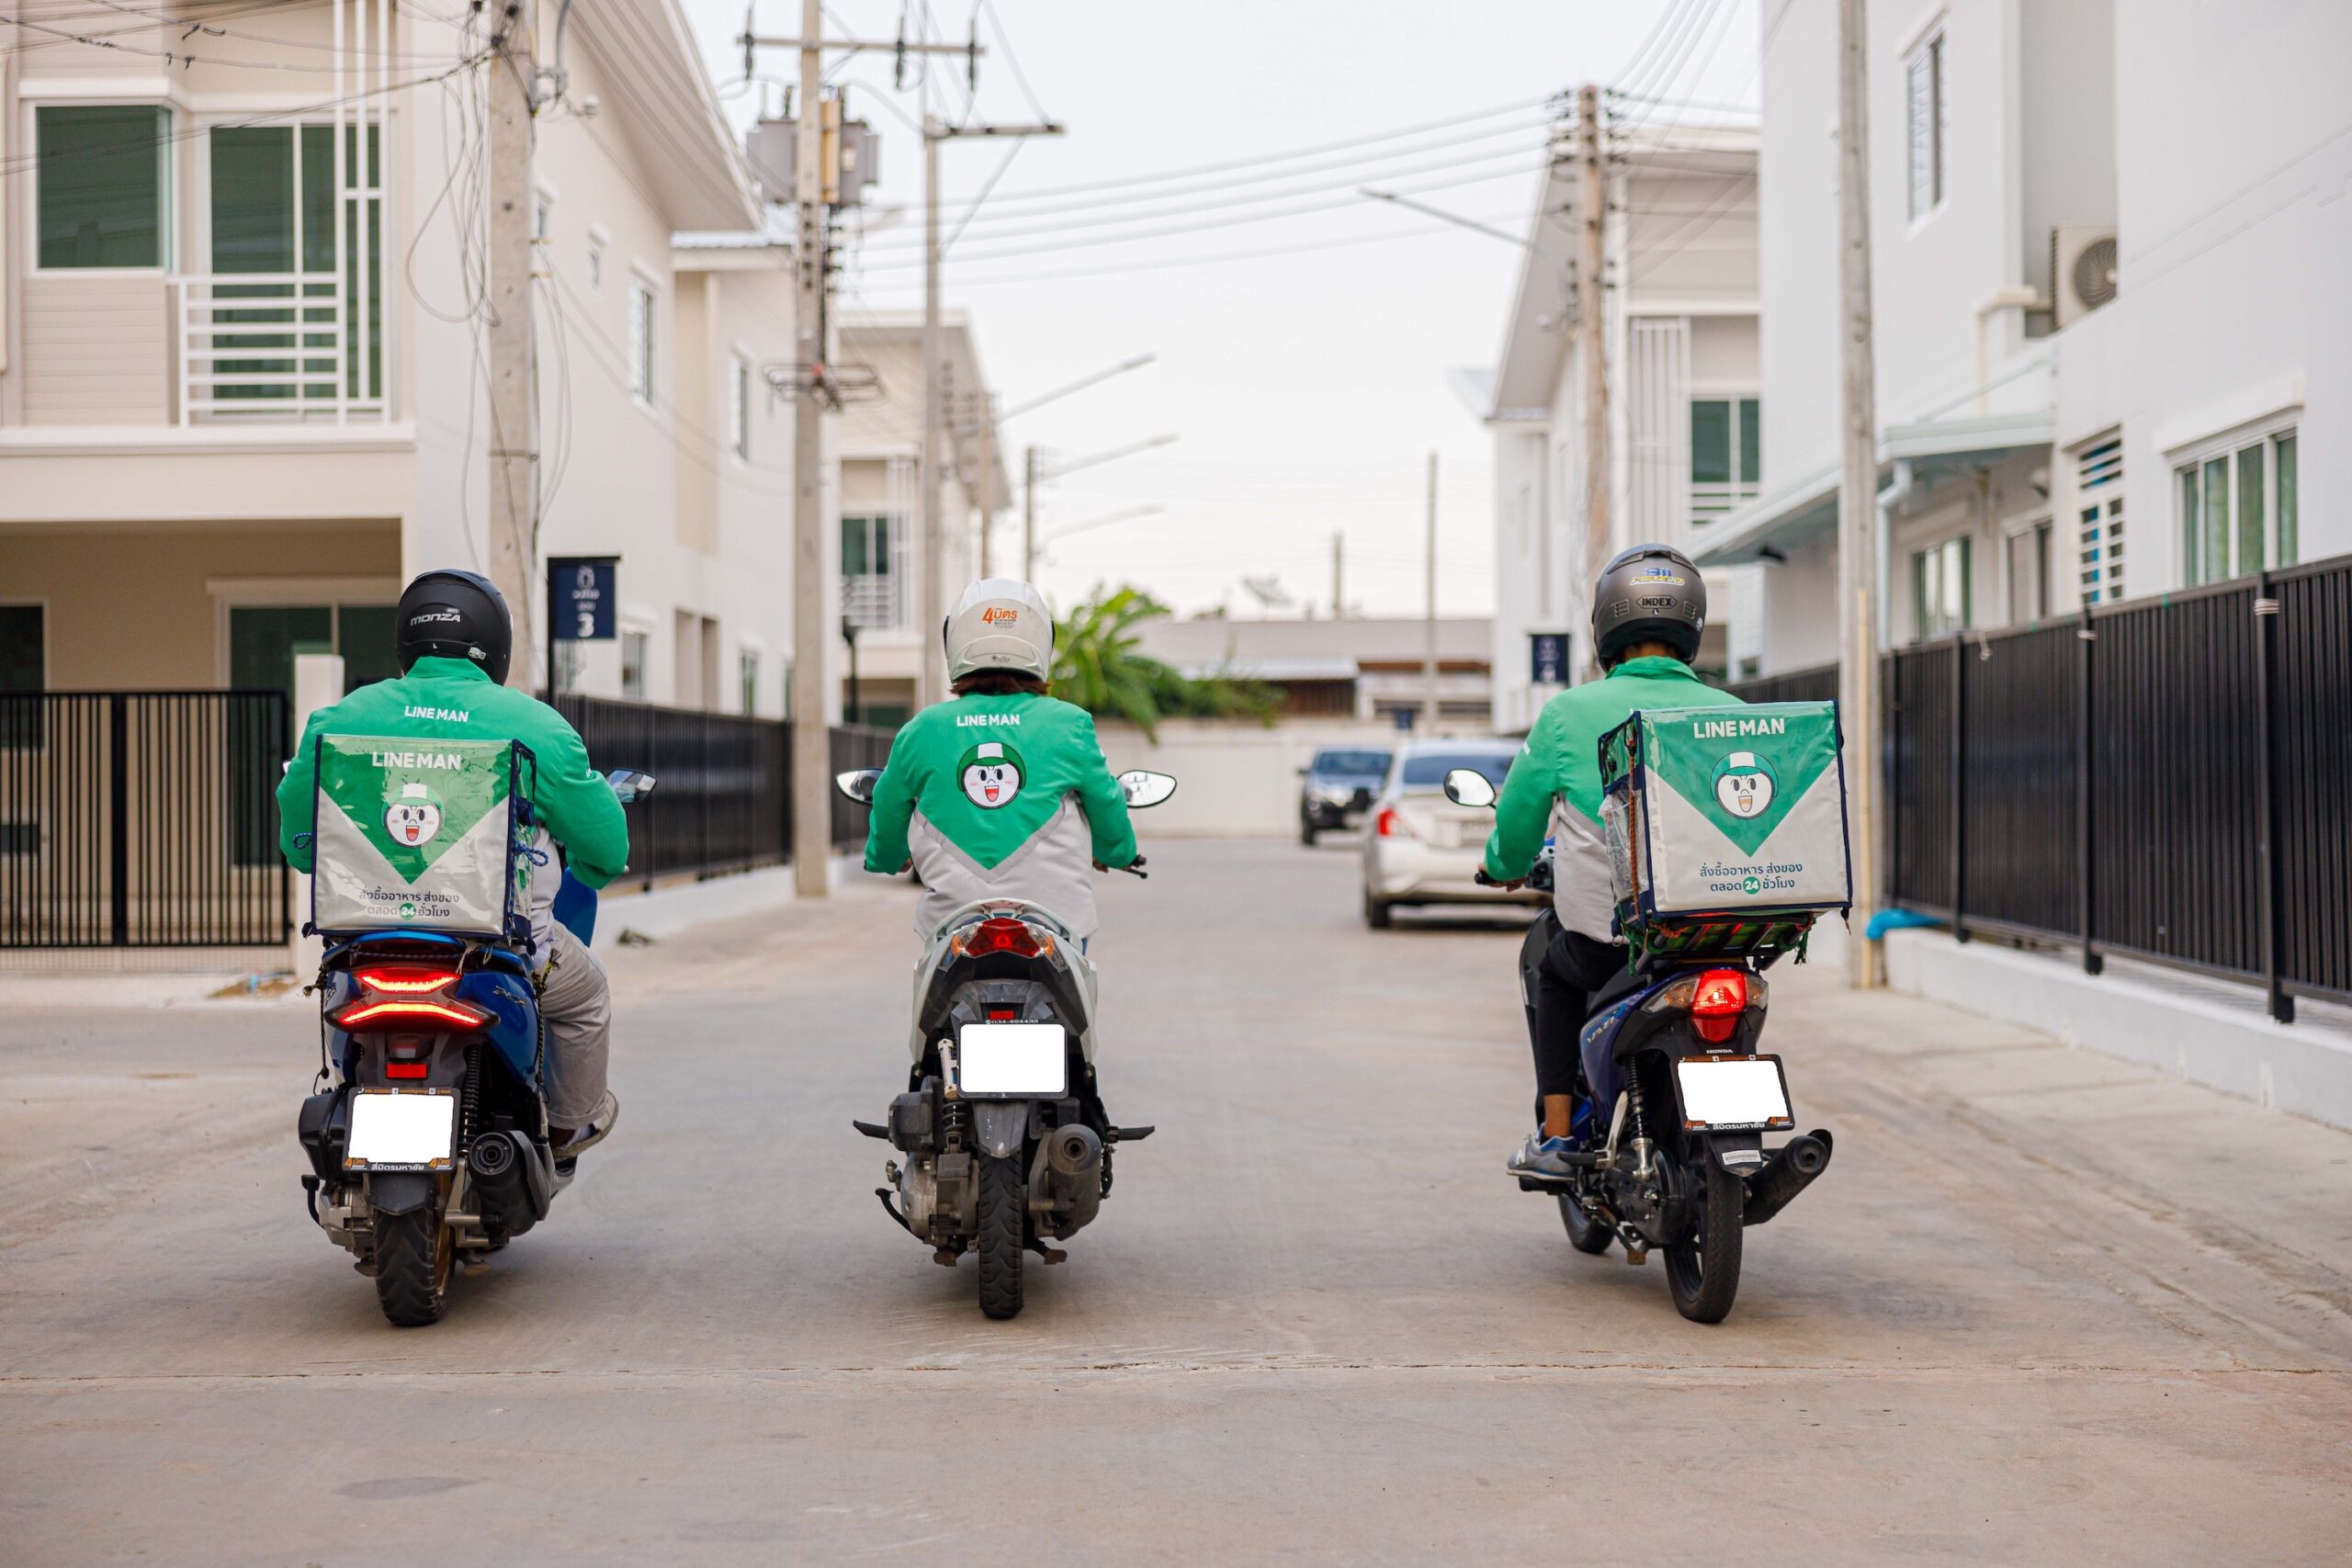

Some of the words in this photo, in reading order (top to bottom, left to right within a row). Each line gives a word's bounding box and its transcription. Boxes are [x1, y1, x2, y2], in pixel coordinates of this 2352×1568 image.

[1642, 597, 1672, 606] INDEX
[577, 612, 595, 637] 3
[404, 705, 435, 719] LINE
[435, 708, 469, 723] MAN
[956, 715, 988, 728] LINE
[989, 714, 1021, 726] MAN
[1693, 720, 1737, 739] LINE
[1739, 717, 1785, 737] MAN
[372, 751, 415, 768] LINE
[416, 752, 461, 770] MAN
[1700, 862, 1764, 877] สั่งซื้ออาหาร
[1766, 862, 1803, 874] ส่งของ
[1710, 882, 1742, 892] ตลอด
[1745, 880, 1759, 891] 24
[1762, 874, 1795, 889] ชั่วโมง
[401, 906, 415, 917] 24
